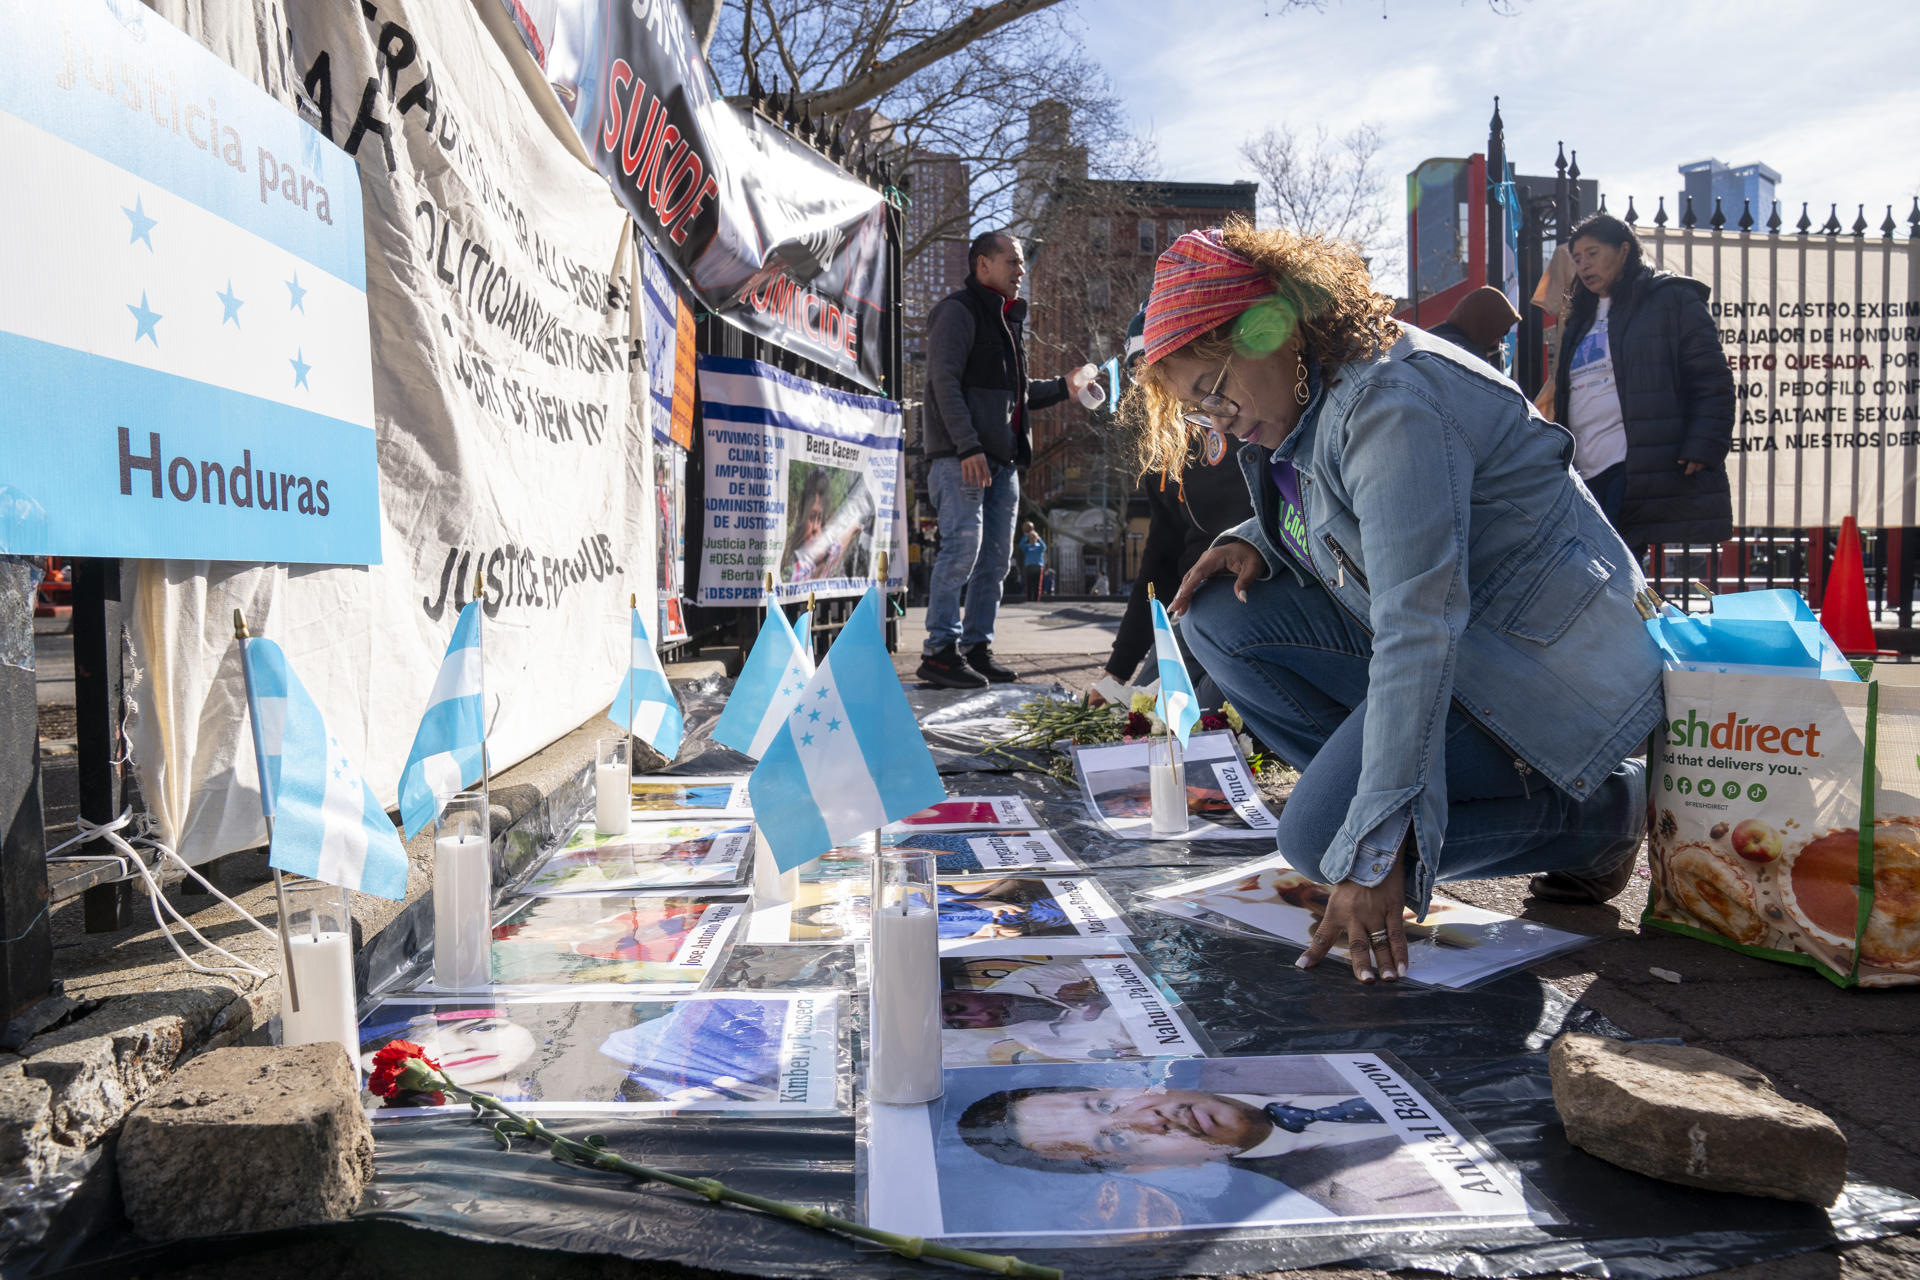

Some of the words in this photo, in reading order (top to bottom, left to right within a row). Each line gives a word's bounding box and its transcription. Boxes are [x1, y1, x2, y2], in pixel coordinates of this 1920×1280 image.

[56, 20, 246, 173] Justicia
[258, 146, 333, 226] para
[603, 58, 719, 247] SUICIDE
[1810, 329, 1834, 343] DE
[1727, 354, 1777, 370] ERTO
[1881, 352, 1920, 369] POR
[1734, 382, 1768, 399] NO,
[775, 437, 784, 449] UN
[807, 435, 830, 455] Berta
[1785, 432, 1880, 449] NUESTROS
[1887, 432, 1920, 447] DER
[728, 448, 761, 463] CLIMA
[763, 451, 773, 464] DE
[117, 426, 330, 517] Honduras
[715, 464, 773, 480] IMPUNIDAD
[775, 469, 779, 480] Y
[729, 482, 745, 495] DE
[748, 484, 771, 497] NULA
[714, 515, 729, 528] DE
[749, 538, 767, 550] Para
[709, 553, 744, 565] #DESA
[721, 569, 754, 580] #Berta
[1677, 753, 1703, 767] that
[1707, 755, 1764, 772] delivers
[1222, 767, 1250, 803] Funez
[1685, 800, 1728, 811] @FRESHDIRECT
[1023, 840, 1056, 863] Murillo
[690, 924, 722, 949] Antonio
[680, 951, 705, 966] Jose
[1113, 963, 1153, 1000] Palacios
[787, 1000, 814, 1040] Fonseca
[1141, 1001, 1184, 1045] Nahum
[780, 1043, 817, 1103] Kimberly
[1353, 1060, 1431, 1121] Barrow
[1408, 1126, 1503, 1196] Anibal
